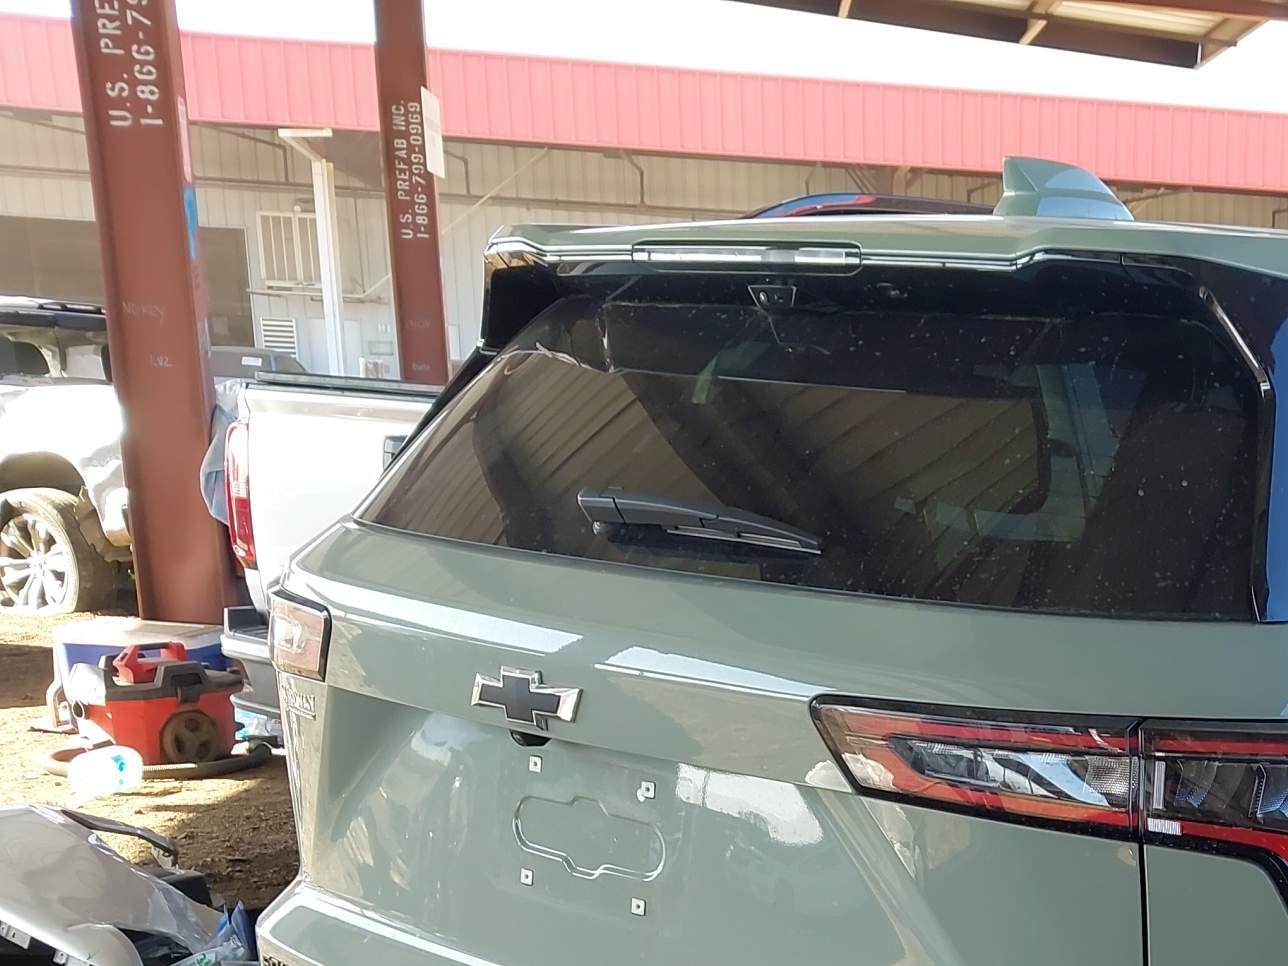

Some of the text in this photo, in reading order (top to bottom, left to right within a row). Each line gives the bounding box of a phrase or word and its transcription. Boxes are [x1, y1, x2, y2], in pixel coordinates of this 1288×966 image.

[105, 73, 132, 126] U.S.
[392, 100, 414, 239] U.S. PREFAB INC.
[408, 102, 430, 239] 1-866-799-0969
